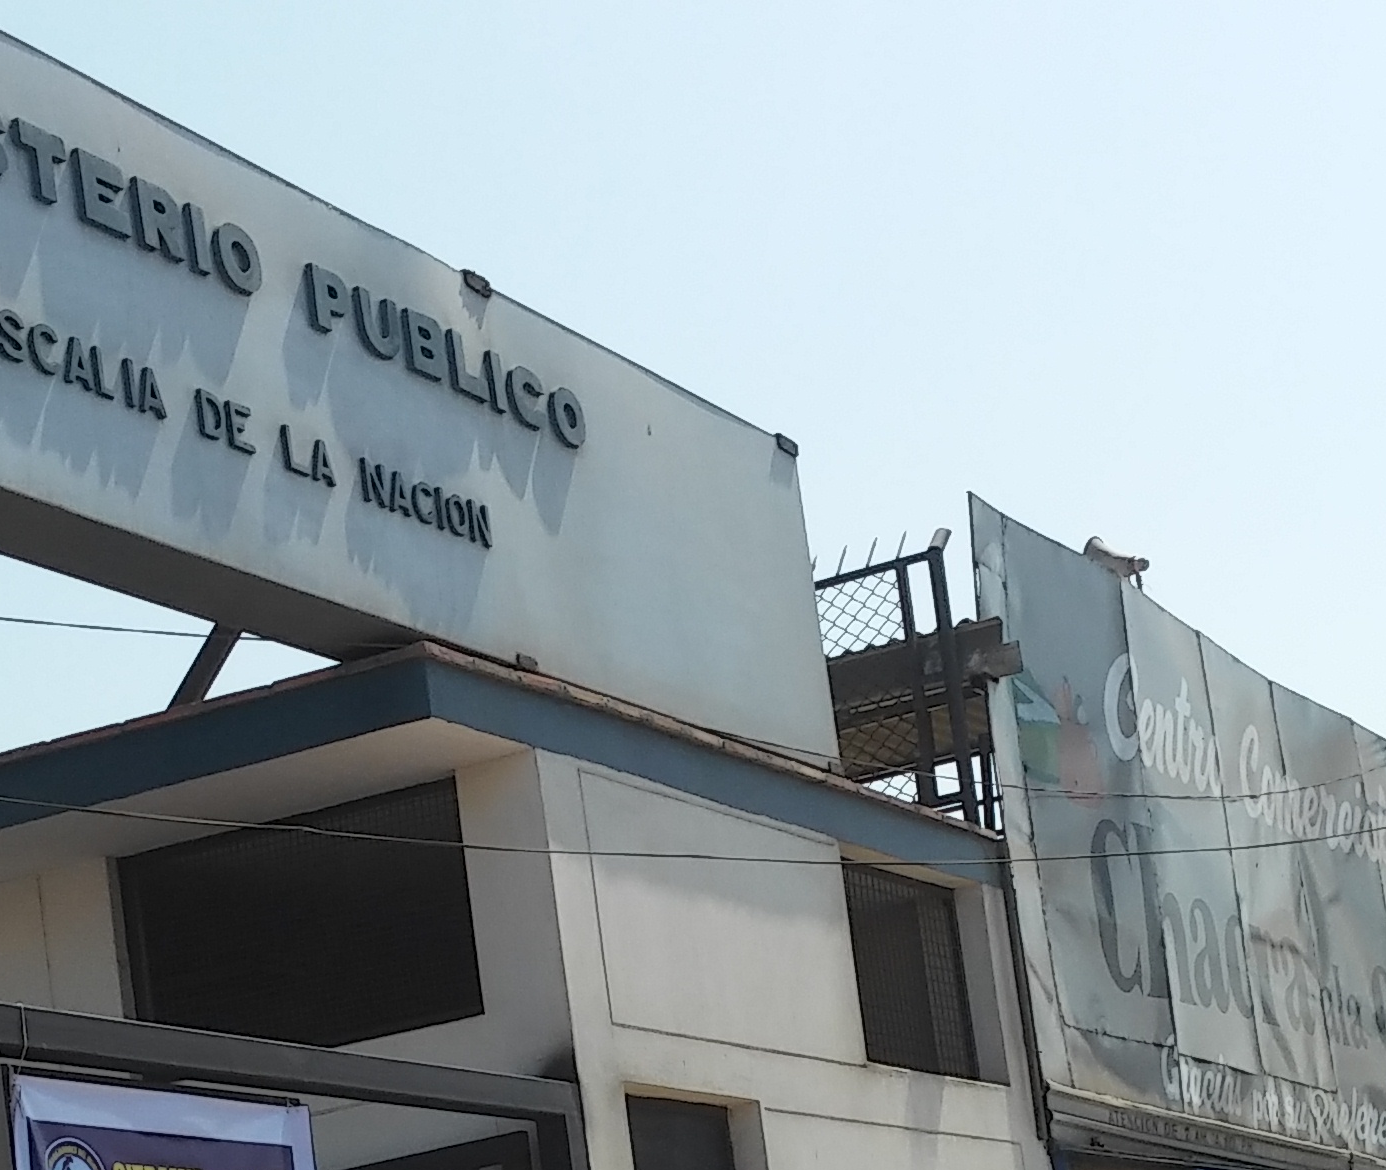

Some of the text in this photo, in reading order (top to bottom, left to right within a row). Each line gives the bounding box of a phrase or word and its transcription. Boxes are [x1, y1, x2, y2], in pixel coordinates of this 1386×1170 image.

[303, 263, 587, 450] PUBLICO
[195, 388, 256, 455] DE
[279, 424, 337, 488] LA
[358, 456, 493, 549] NACION
